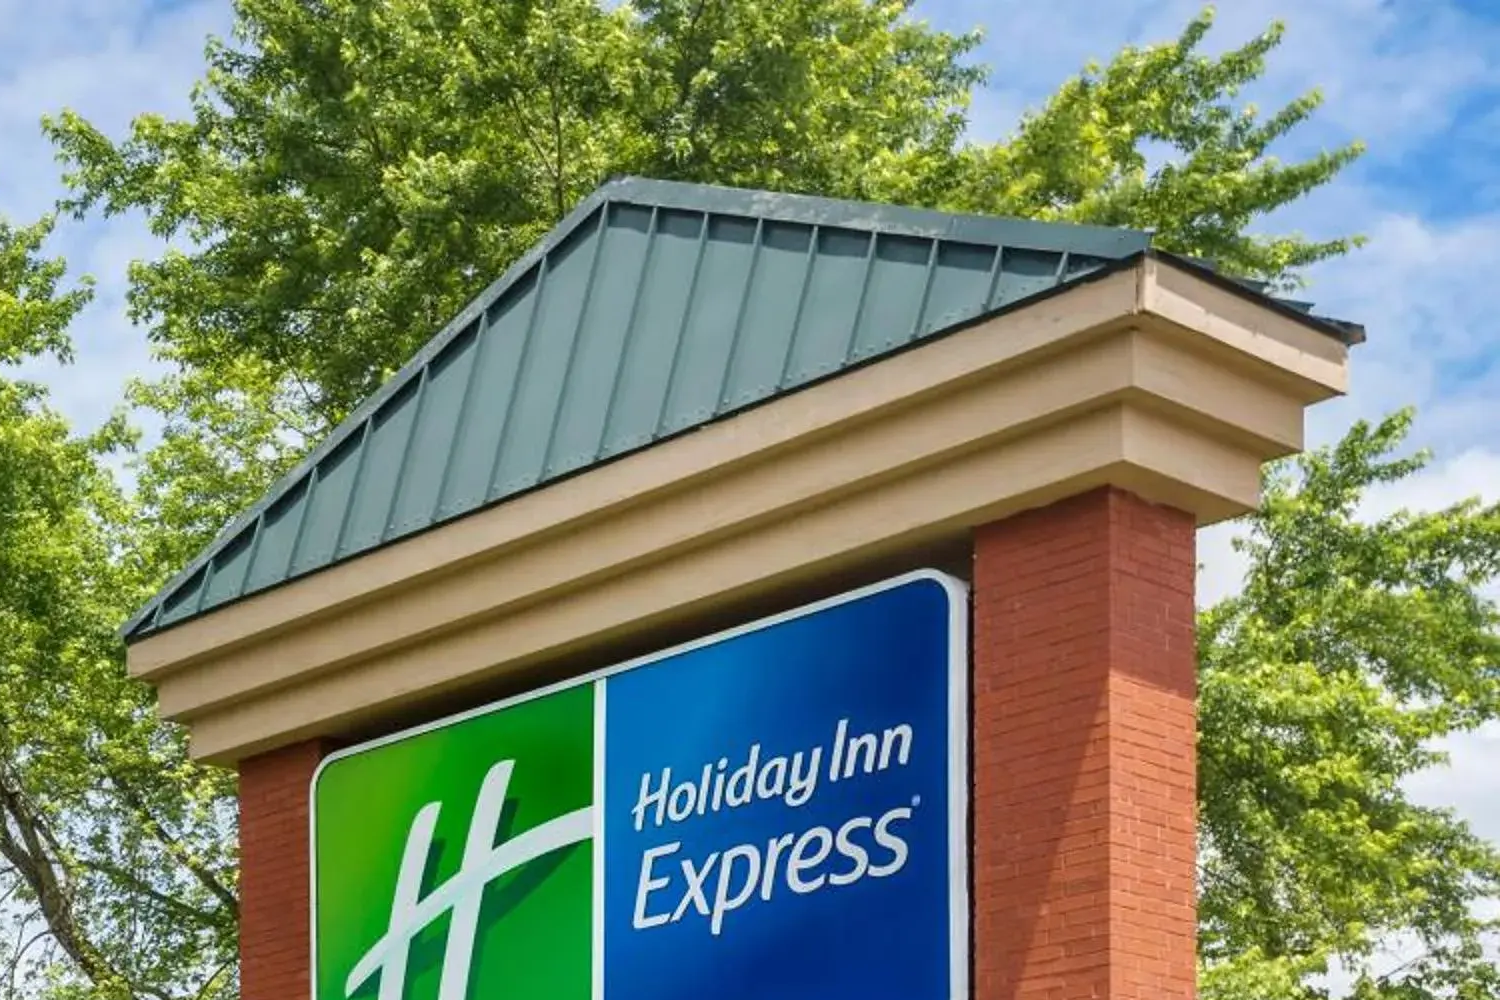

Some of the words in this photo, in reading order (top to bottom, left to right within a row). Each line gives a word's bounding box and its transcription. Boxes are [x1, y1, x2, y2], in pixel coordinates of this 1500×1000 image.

[631, 743, 822, 832] Holiday
[829, 718, 912, 783] Inn
[632, 807, 912, 936] Express
